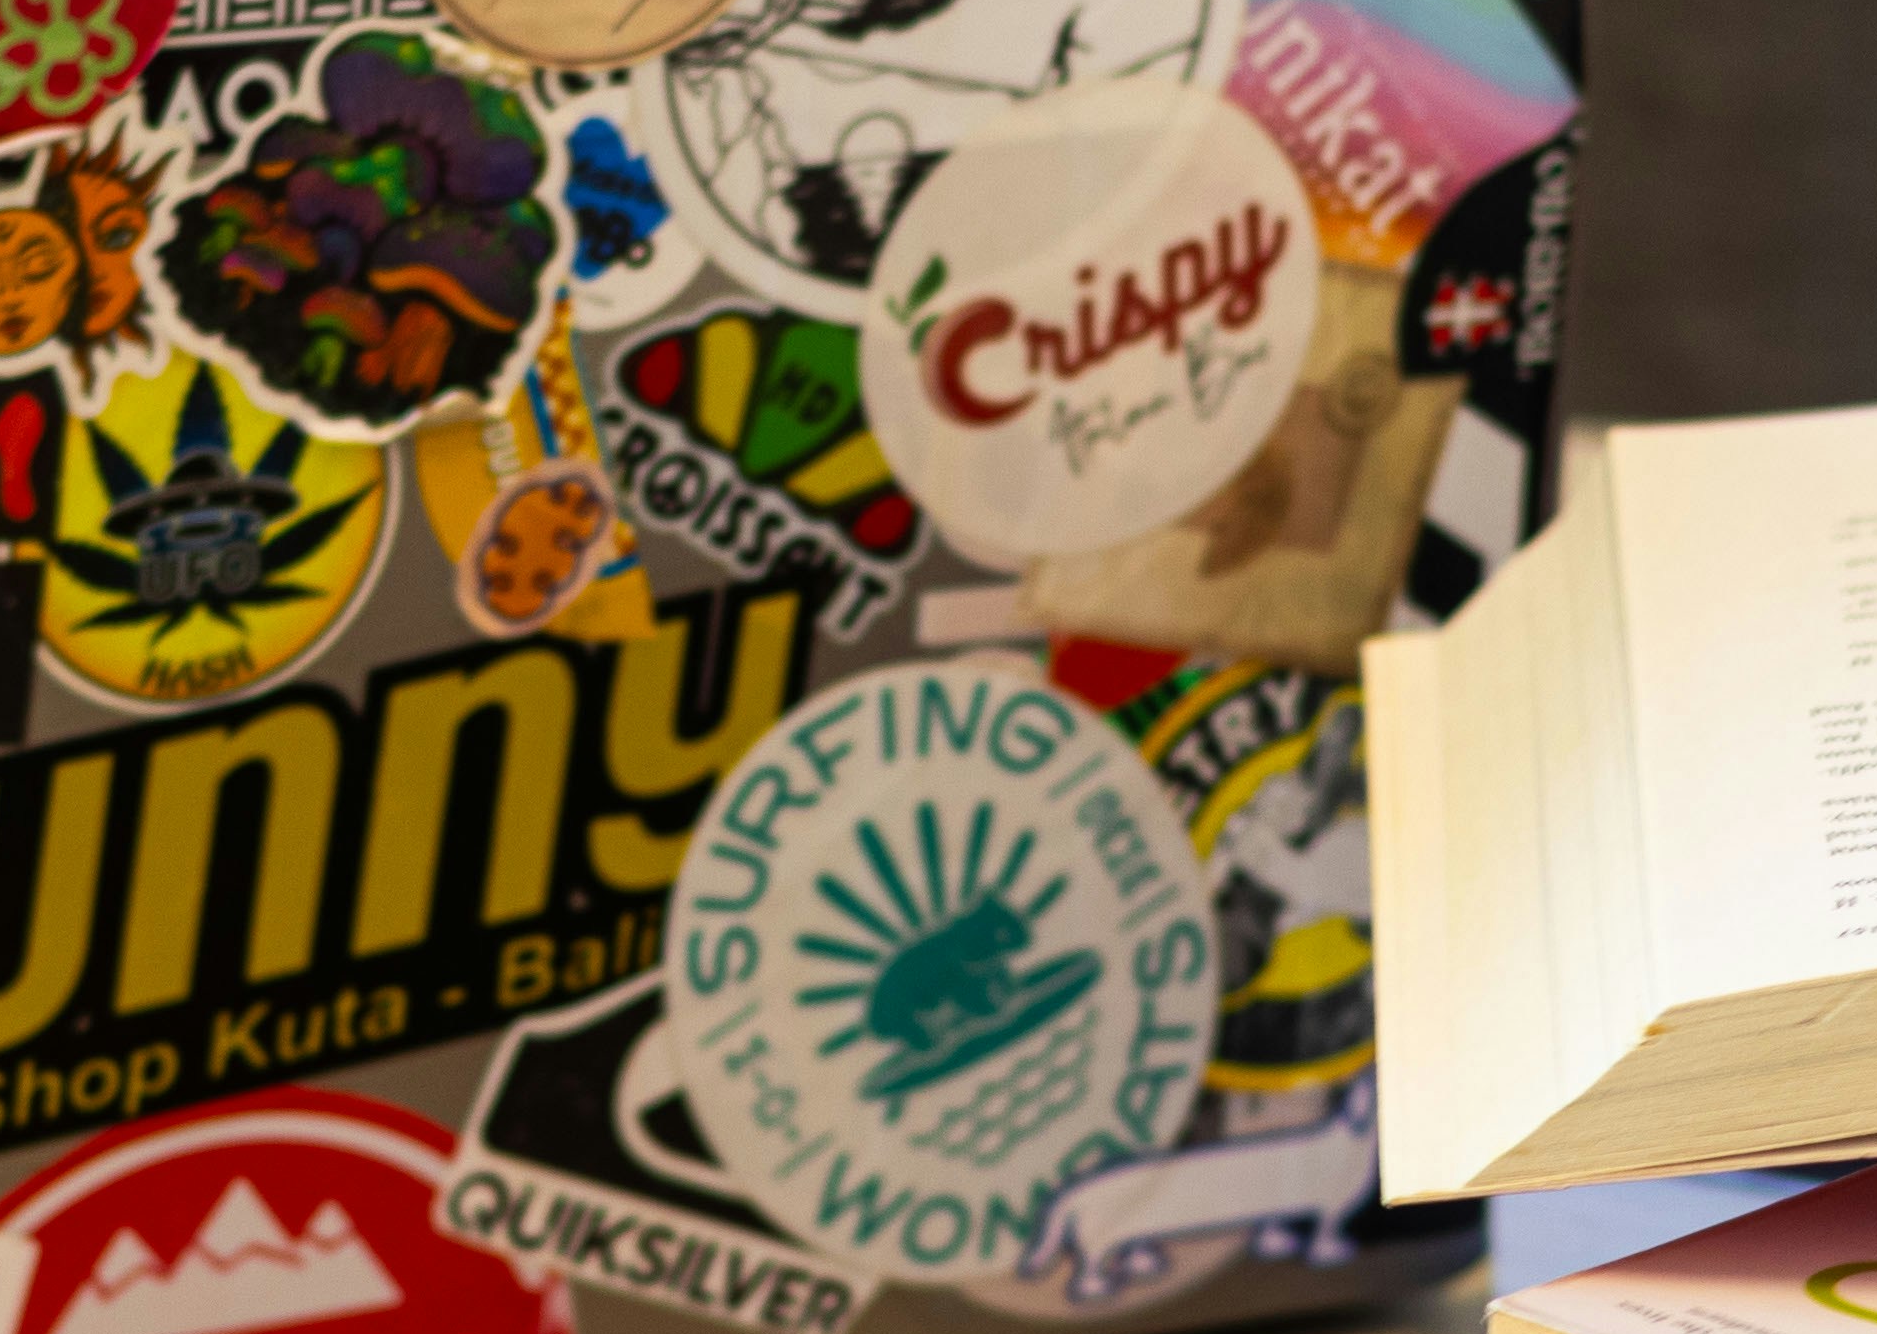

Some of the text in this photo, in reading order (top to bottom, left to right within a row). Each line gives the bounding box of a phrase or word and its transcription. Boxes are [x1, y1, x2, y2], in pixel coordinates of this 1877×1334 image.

[927, 201, 1288, 429] Crispy
[138, 542, 262, 605] UFO
[688, 679, 1075, 997] SURFING
[211, 983, 407, 1078] Kuta
[498, 915, 659, 1008] Bali
